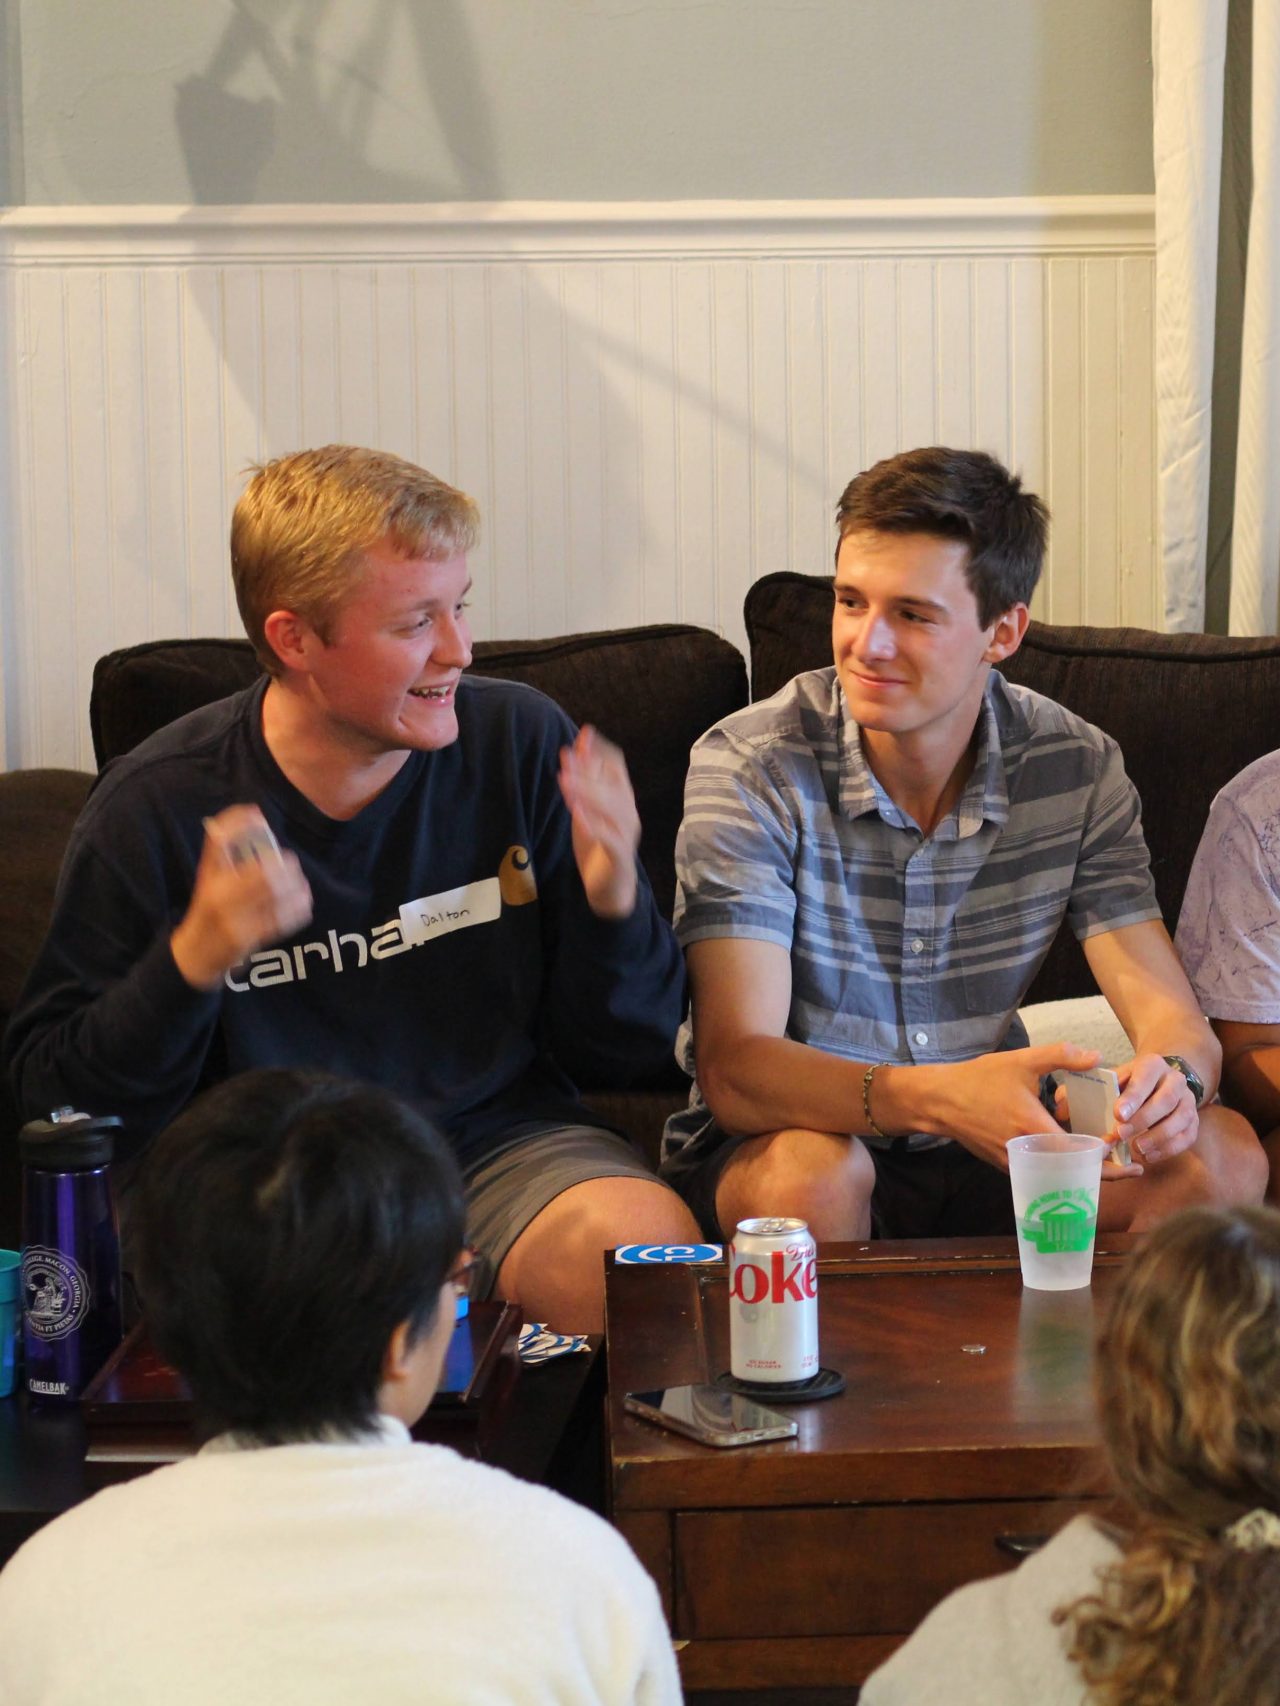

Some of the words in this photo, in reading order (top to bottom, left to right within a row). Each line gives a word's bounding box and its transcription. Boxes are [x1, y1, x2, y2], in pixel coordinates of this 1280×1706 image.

[420, 907, 471, 928] Dalton
[224, 919, 424, 992] carha
[729, 1241, 818, 1304] oke
[29, 1378, 67, 1396] CAMELBAK
